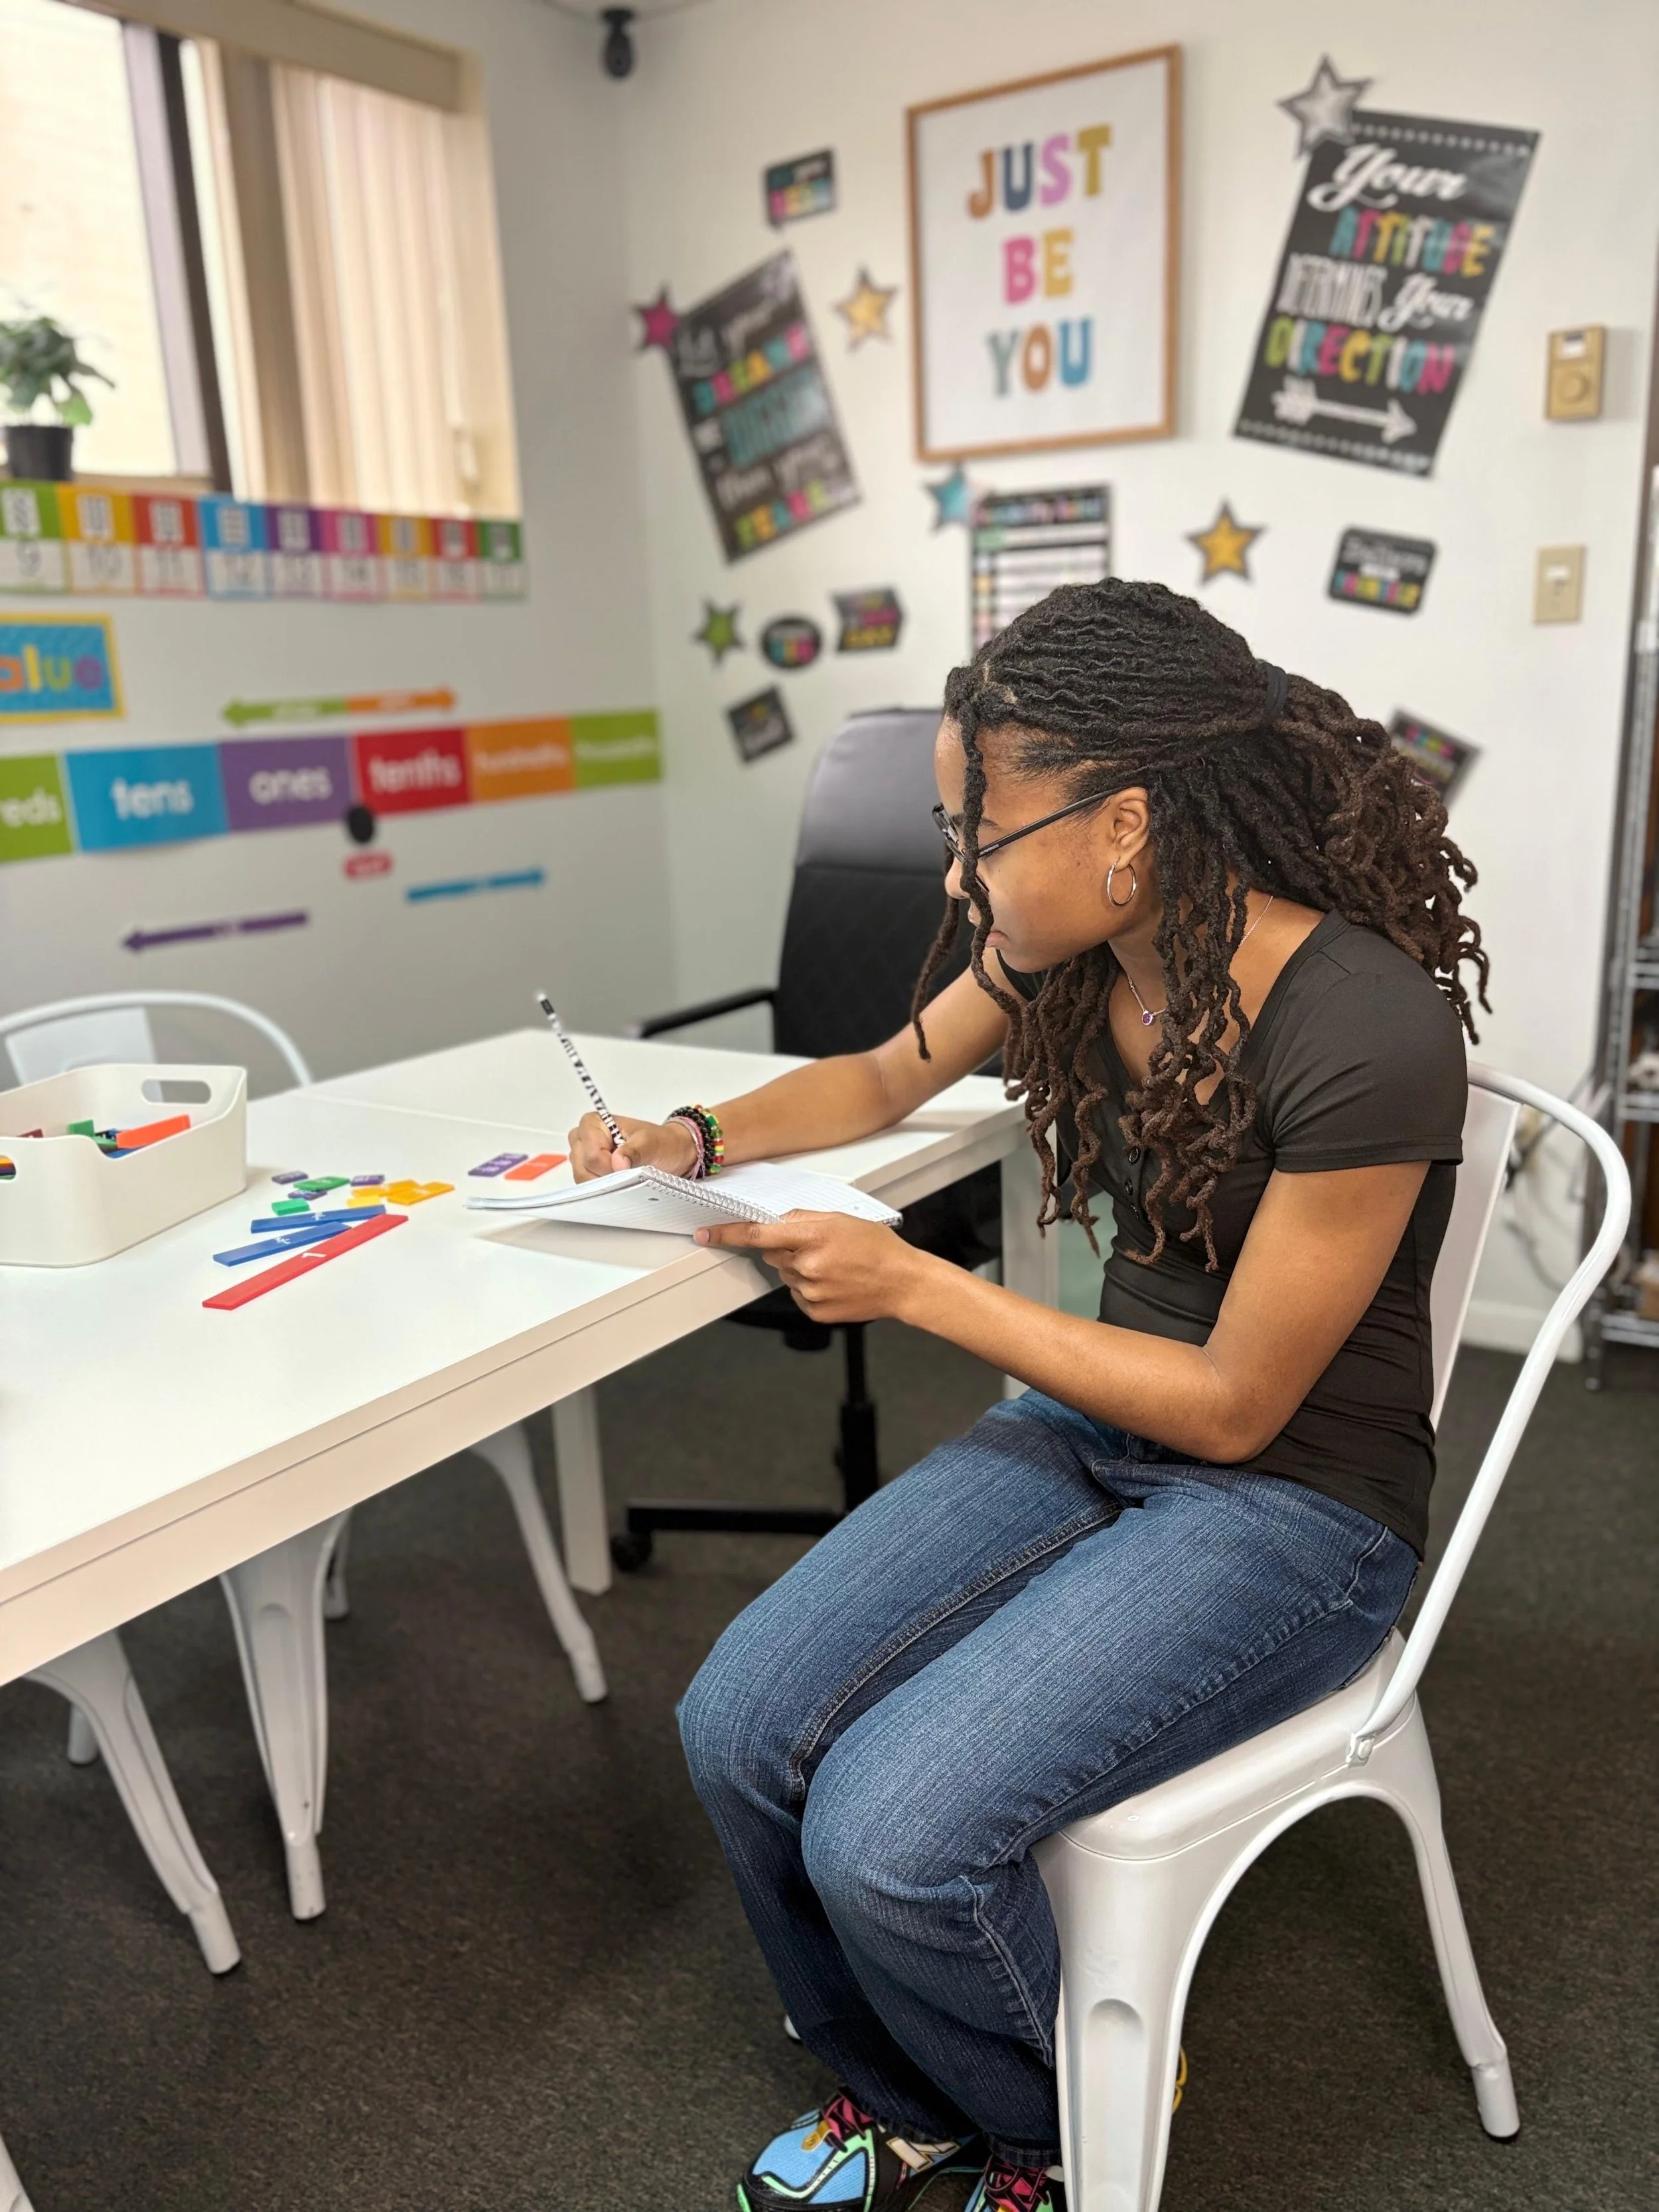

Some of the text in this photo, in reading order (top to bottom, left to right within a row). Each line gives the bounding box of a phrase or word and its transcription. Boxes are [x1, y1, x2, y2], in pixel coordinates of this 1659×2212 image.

[967, 123, 1113, 222] JUST
[1305, 142, 1467, 213] Your
[1003, 228, 1075, 306] BE
[1329, 204, 1496, 278] ATTITUDE
[1376, 272, 1475, 333] Your
[985, 316, 1093, 398] YOU
[1263, 315, 1456, 395] DIRECTION
[110, 776, 194, 822] tens
[248, 766, 332, 804] ones
